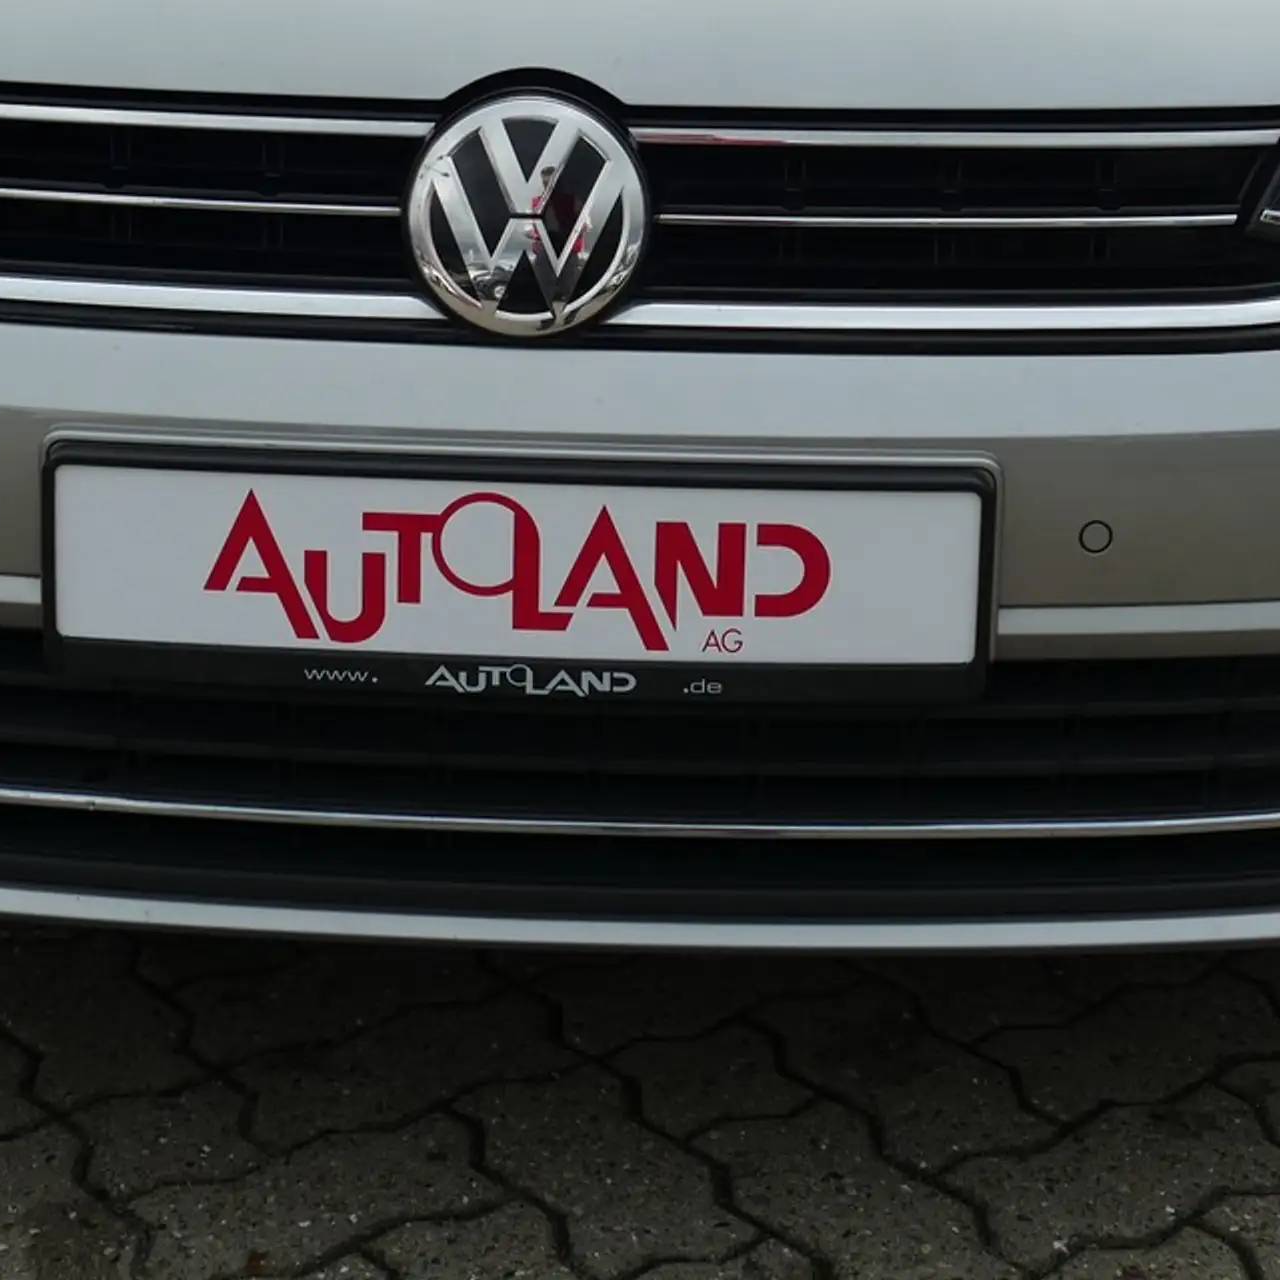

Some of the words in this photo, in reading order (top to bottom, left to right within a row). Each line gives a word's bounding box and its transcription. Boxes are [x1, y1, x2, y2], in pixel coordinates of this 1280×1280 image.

[409, 96, 645, 336] VW
[204, 488, 831, 651] AUTOLAND
[303, 667, 379, 684] www.
[424, 663, 637, 697] AUTOLAND
[682, 677, 722, 695] .de
[701, 629, 743, 653] AG
